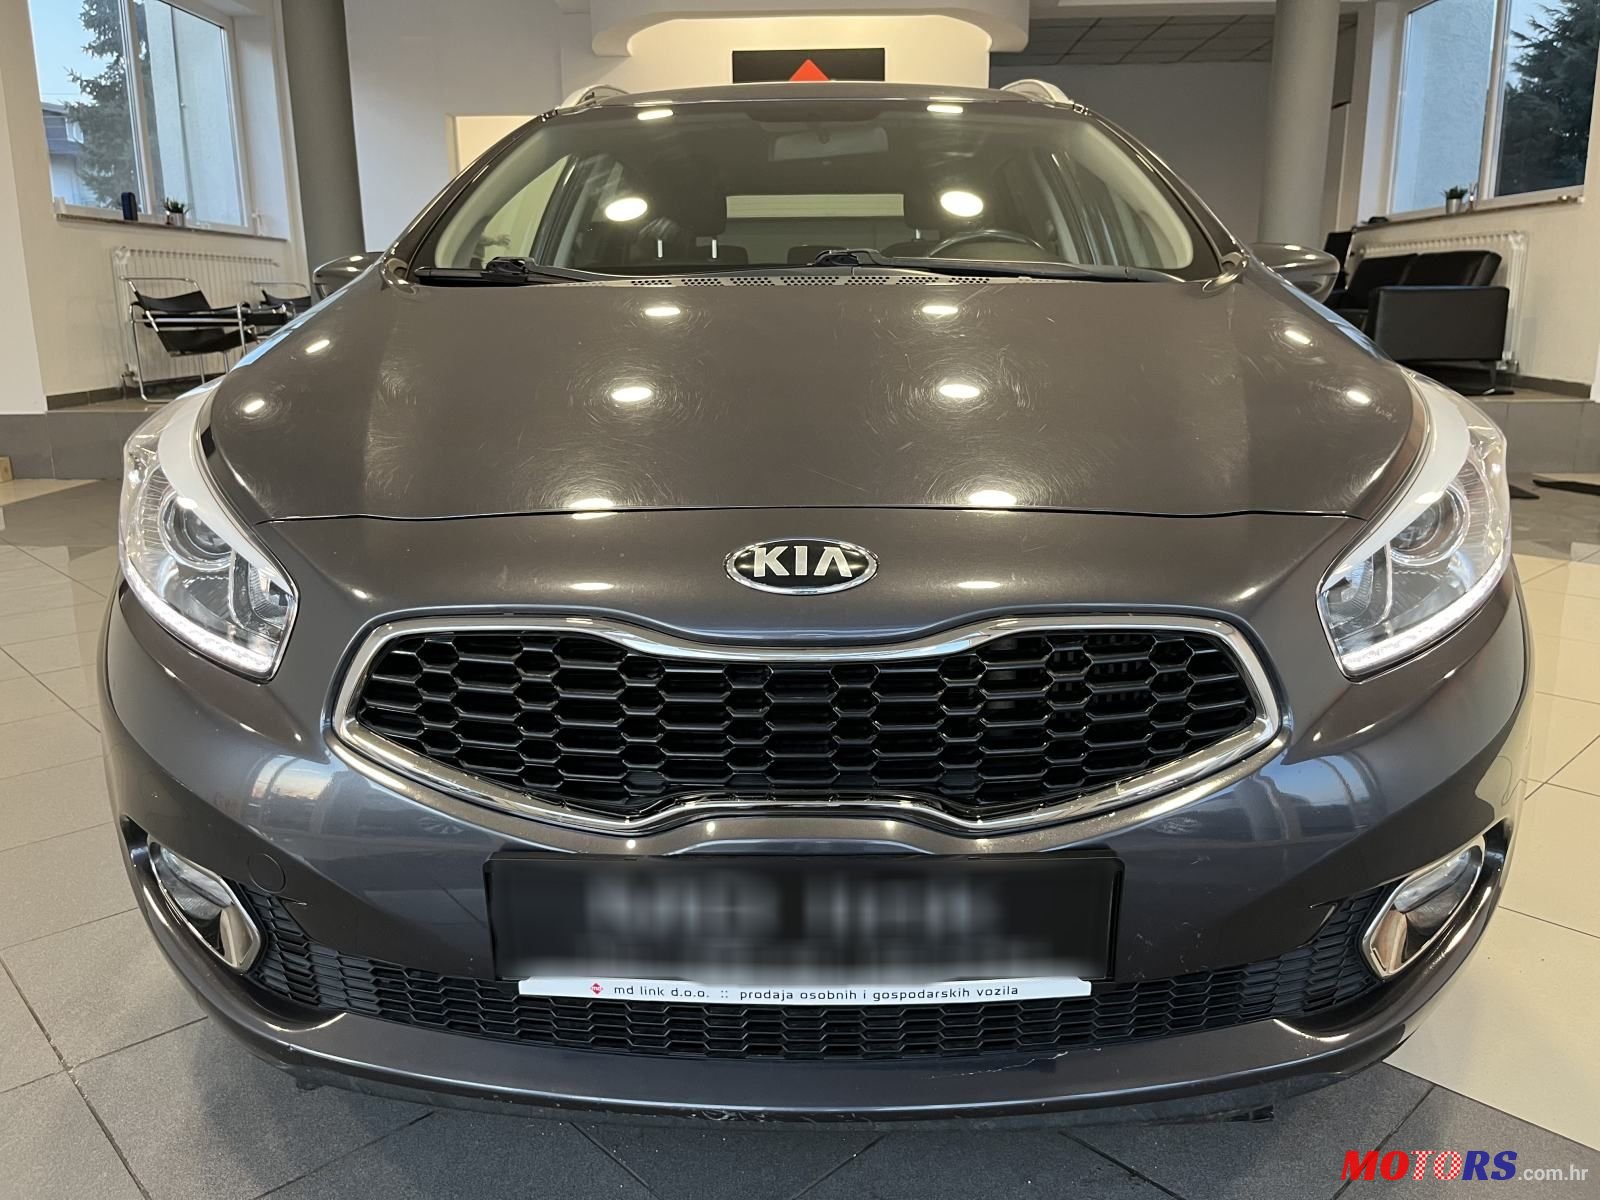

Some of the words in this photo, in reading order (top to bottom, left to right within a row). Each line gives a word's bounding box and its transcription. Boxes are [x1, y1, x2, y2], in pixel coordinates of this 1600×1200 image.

[753, 545, 853, 578] KIA
[613, 985, 634, 995] md
[640, 985, 664, 996] link
[671, 988, 709, 998] d.o.o.
[740, 990, 793, 1001] prodaja
[800, 990, 857, 1000] osobnih
[863, 990, 866, 999] i
[873, 988, 970, 1001] gospodarskih
[976, 985, 1018, 997] vozila
